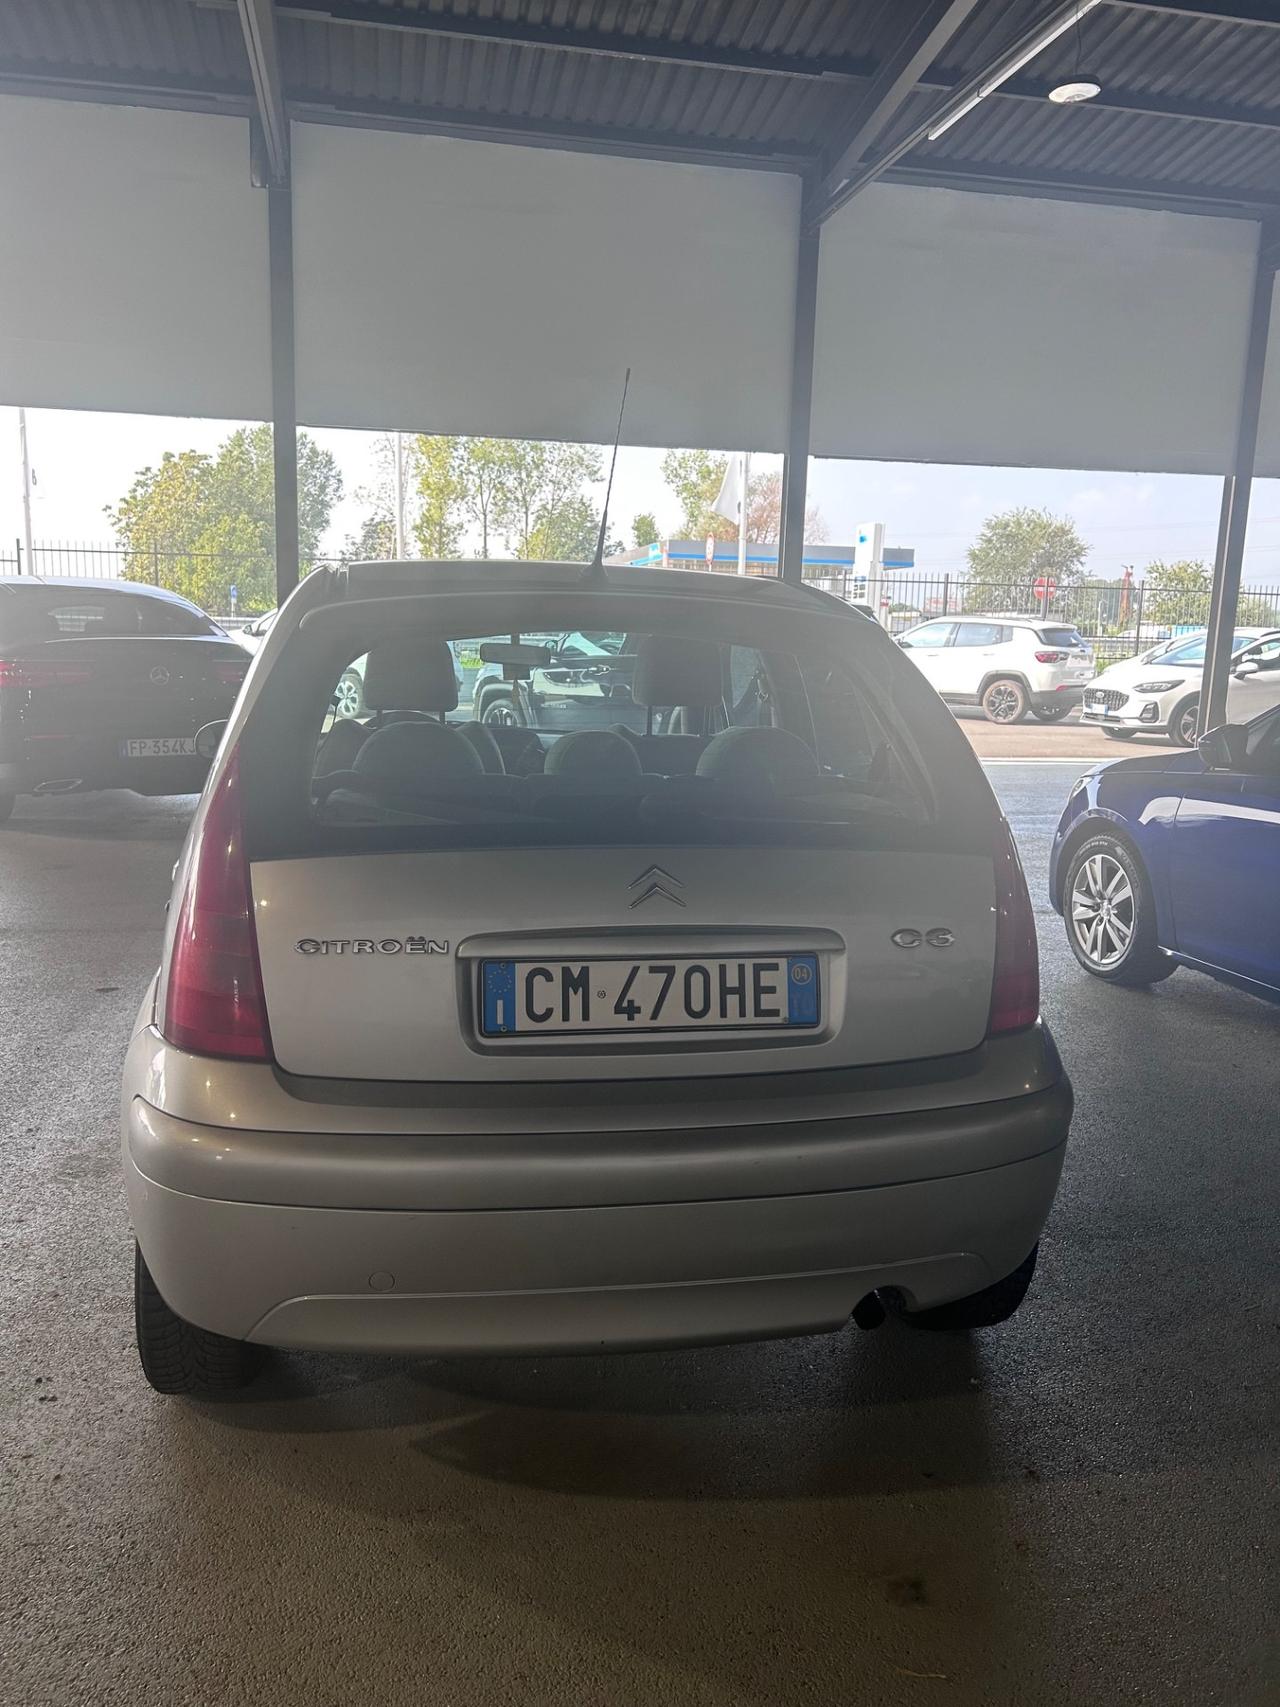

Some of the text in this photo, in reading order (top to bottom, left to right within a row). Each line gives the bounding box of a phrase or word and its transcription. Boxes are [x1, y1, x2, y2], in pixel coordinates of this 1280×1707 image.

[130, 741, 147, 755] FP
[294, 936, 448, 954] CITROËN
[890, 927, 956, 948] C3
[525, 963, 780, 1023] CM 470HE
